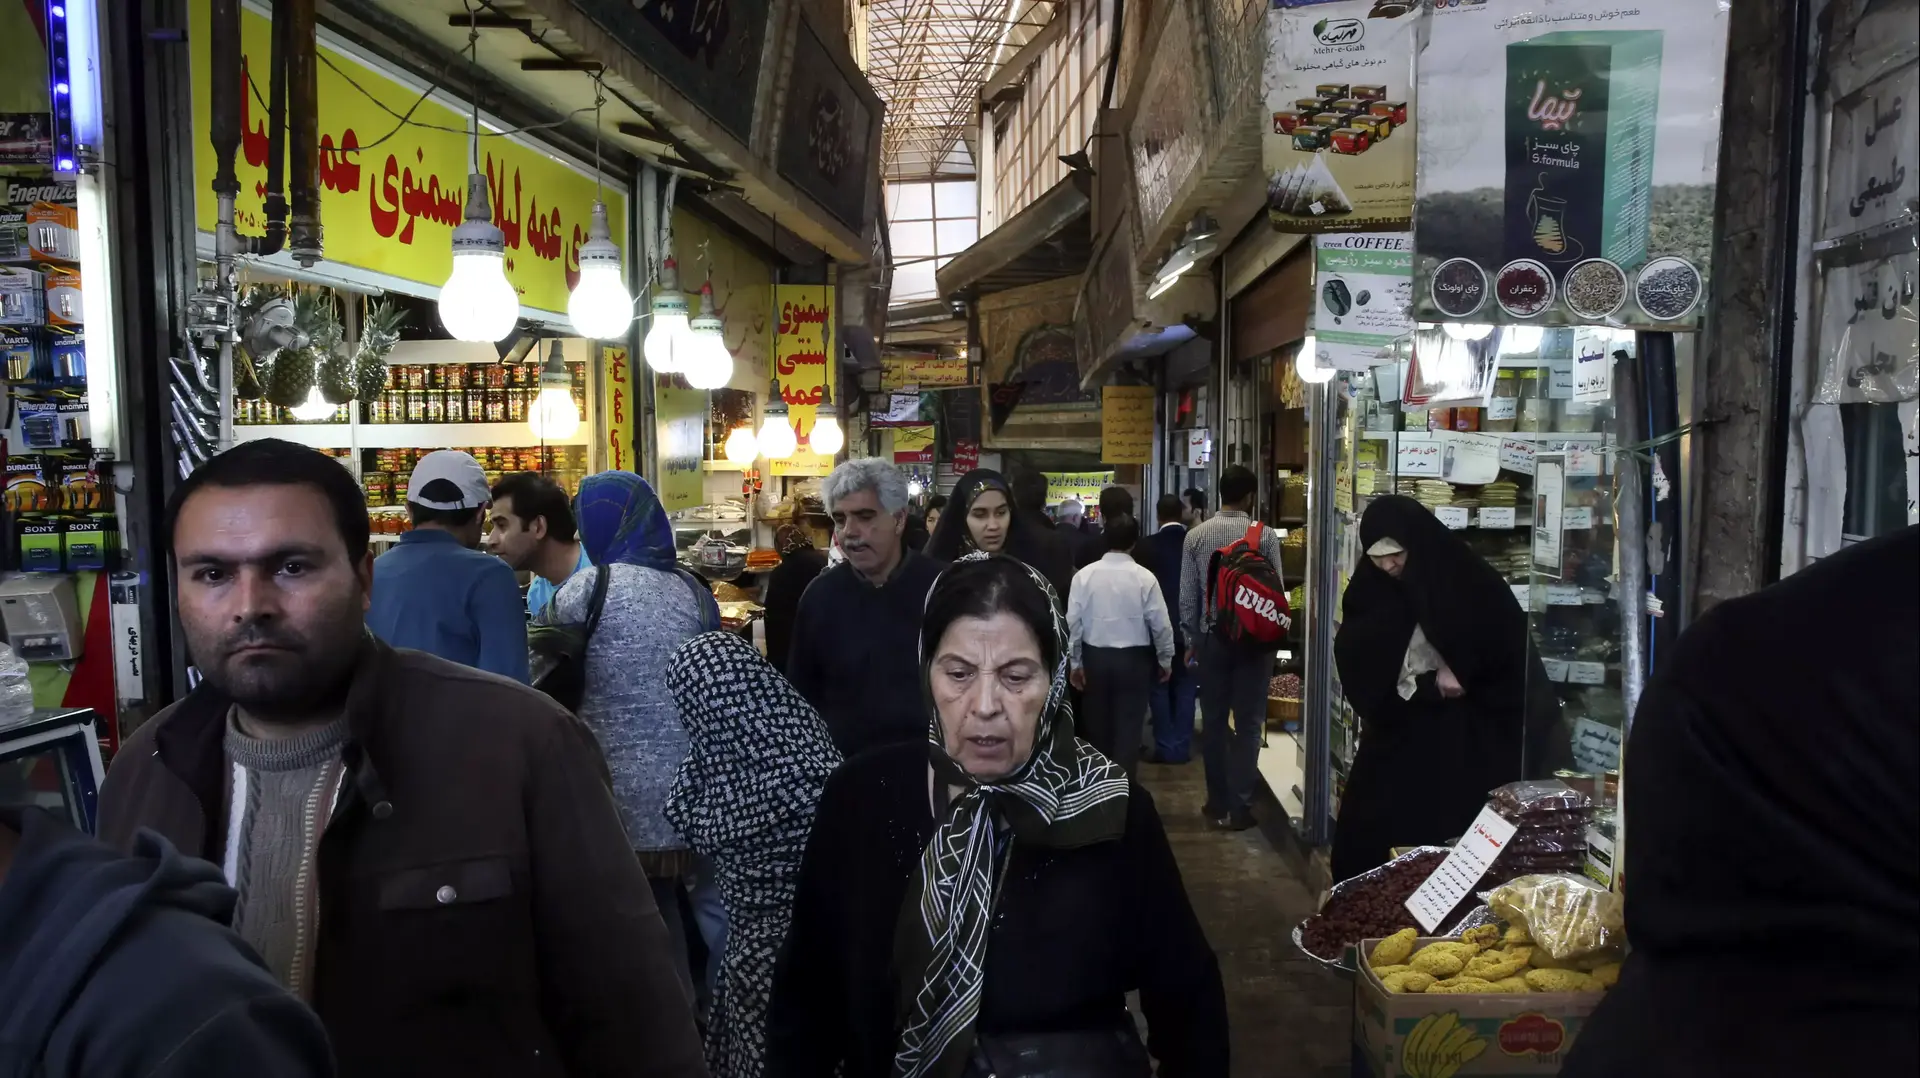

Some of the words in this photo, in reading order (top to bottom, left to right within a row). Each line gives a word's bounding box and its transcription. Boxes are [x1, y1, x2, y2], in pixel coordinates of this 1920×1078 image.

[1552, 12, 1587, 22] متناسب
[1594, 9, 1620, 21] خوش
[1620, 7, 1640, 17] طعم
[1313, 44, 1365, 55] Mehr-e-Giah
[1294, 63, 1321, 72] مخلوط
[1322, 58, 1344, 71] گیاهی
[1345, 59, 1360, 69] های
[1360, 59, 1376, 67] نوش
[1865, 95, 1902, 147] عسل
[1532, 137, 1559, 150] سبز
[1560, 141, 1580, 156] چای
[319, 128, 360, 194] عم
[1532, 153, 1580, 169] S.formula
[7, 183, 77, 202] Energize
[1849, 155, 1905, 218] طبیعی
[370, 146, 462, 245] سمنوی
[0, 212, 23, 224] rgizer
[527, 194, 561, 260] عمه
[1323, 241, 1342, 249] green
[1344, 236, 1404, 251] COFFEE
[1361, 254, 1383, 268] سبز
[1465, 284, 1479, 295] چای
[1509, 284, 1537, 295] زعفران
[1586, 285, 1603, 294] زیره
[778, 294, 829, 335] سمنوی
[777, 337, 827, 375] سنتی
[610, 350, 626, 384] لیلا
[780, 383, 823, 405] عمه
[20, 402, 57, 412] Energizer
[614, 388, 624, 424] عمه
[69, 523, 98, 531] SONY
[1235, 584, 1292, 631] Wilson
[127, 627, 139, 657] دربهای
[129, 657, 139, 677] نصب
